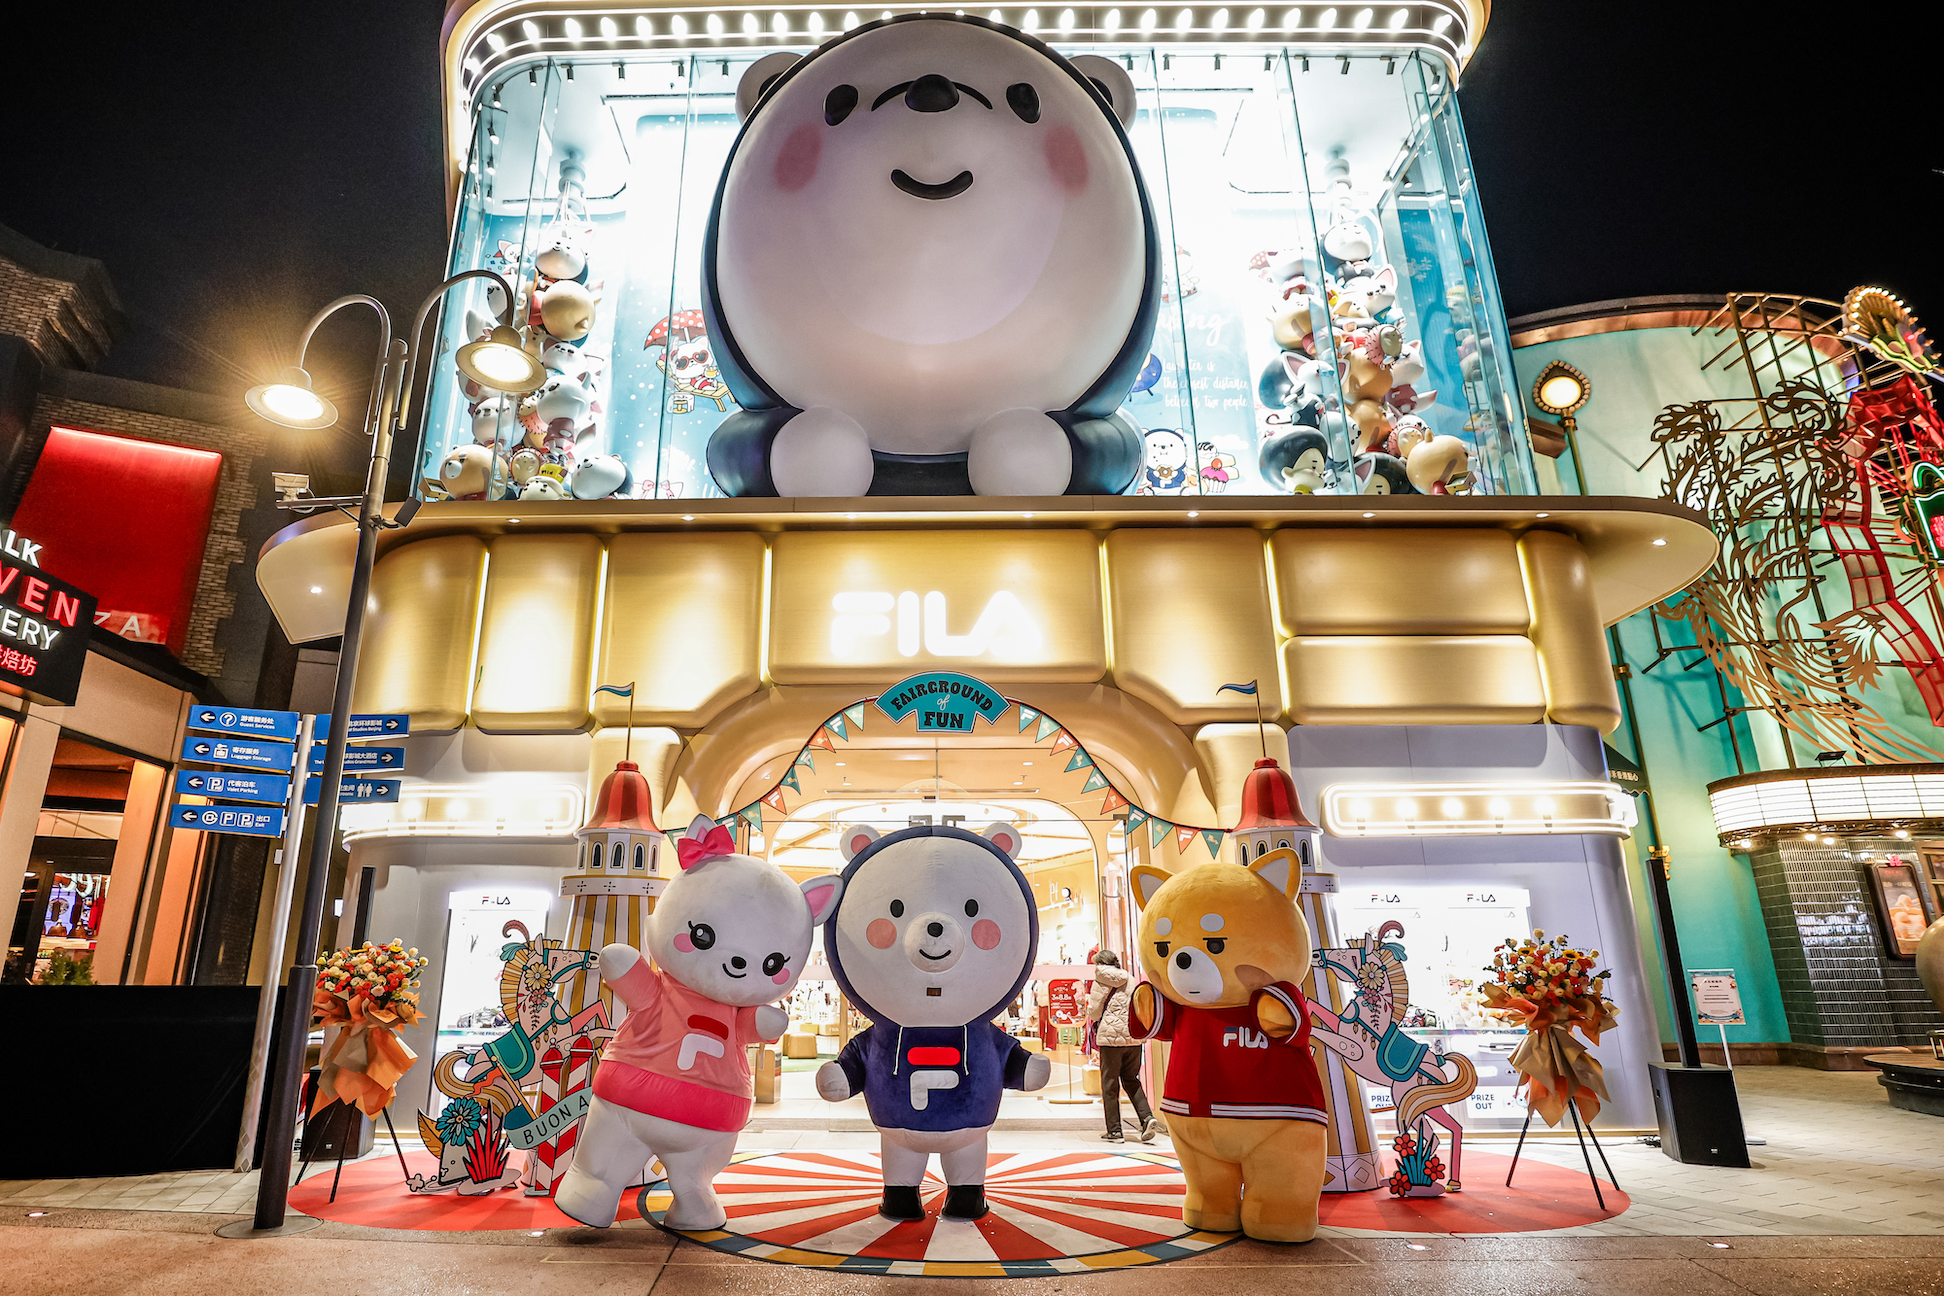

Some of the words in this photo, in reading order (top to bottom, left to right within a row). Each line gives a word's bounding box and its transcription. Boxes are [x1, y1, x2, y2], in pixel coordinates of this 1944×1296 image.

[1163, 359, 1202, 375] Laugter
[1180, 376, 1212, 390] clsest
[1165, 394, 1199, 409] betwen
[0, 529, 43, 568] LK
[0, 605, 60, 650] ERY
[831, 590, 1043, 657] FILA
[0, 644, 38, 677] 焙坊
[891, 680, 994, 711] FAIRGROUND
[936, 694, 950, 711] of
[924, 711, 964, 729] FUN
[240, 787, 258, 795] Parking
[256, 815, 271, 823] 出口
[1223, 1026, 1268, 1049] FILA
[1475, 1102, 1493, 1110] OUT
[523, 1104, 572, 1145] BUON
